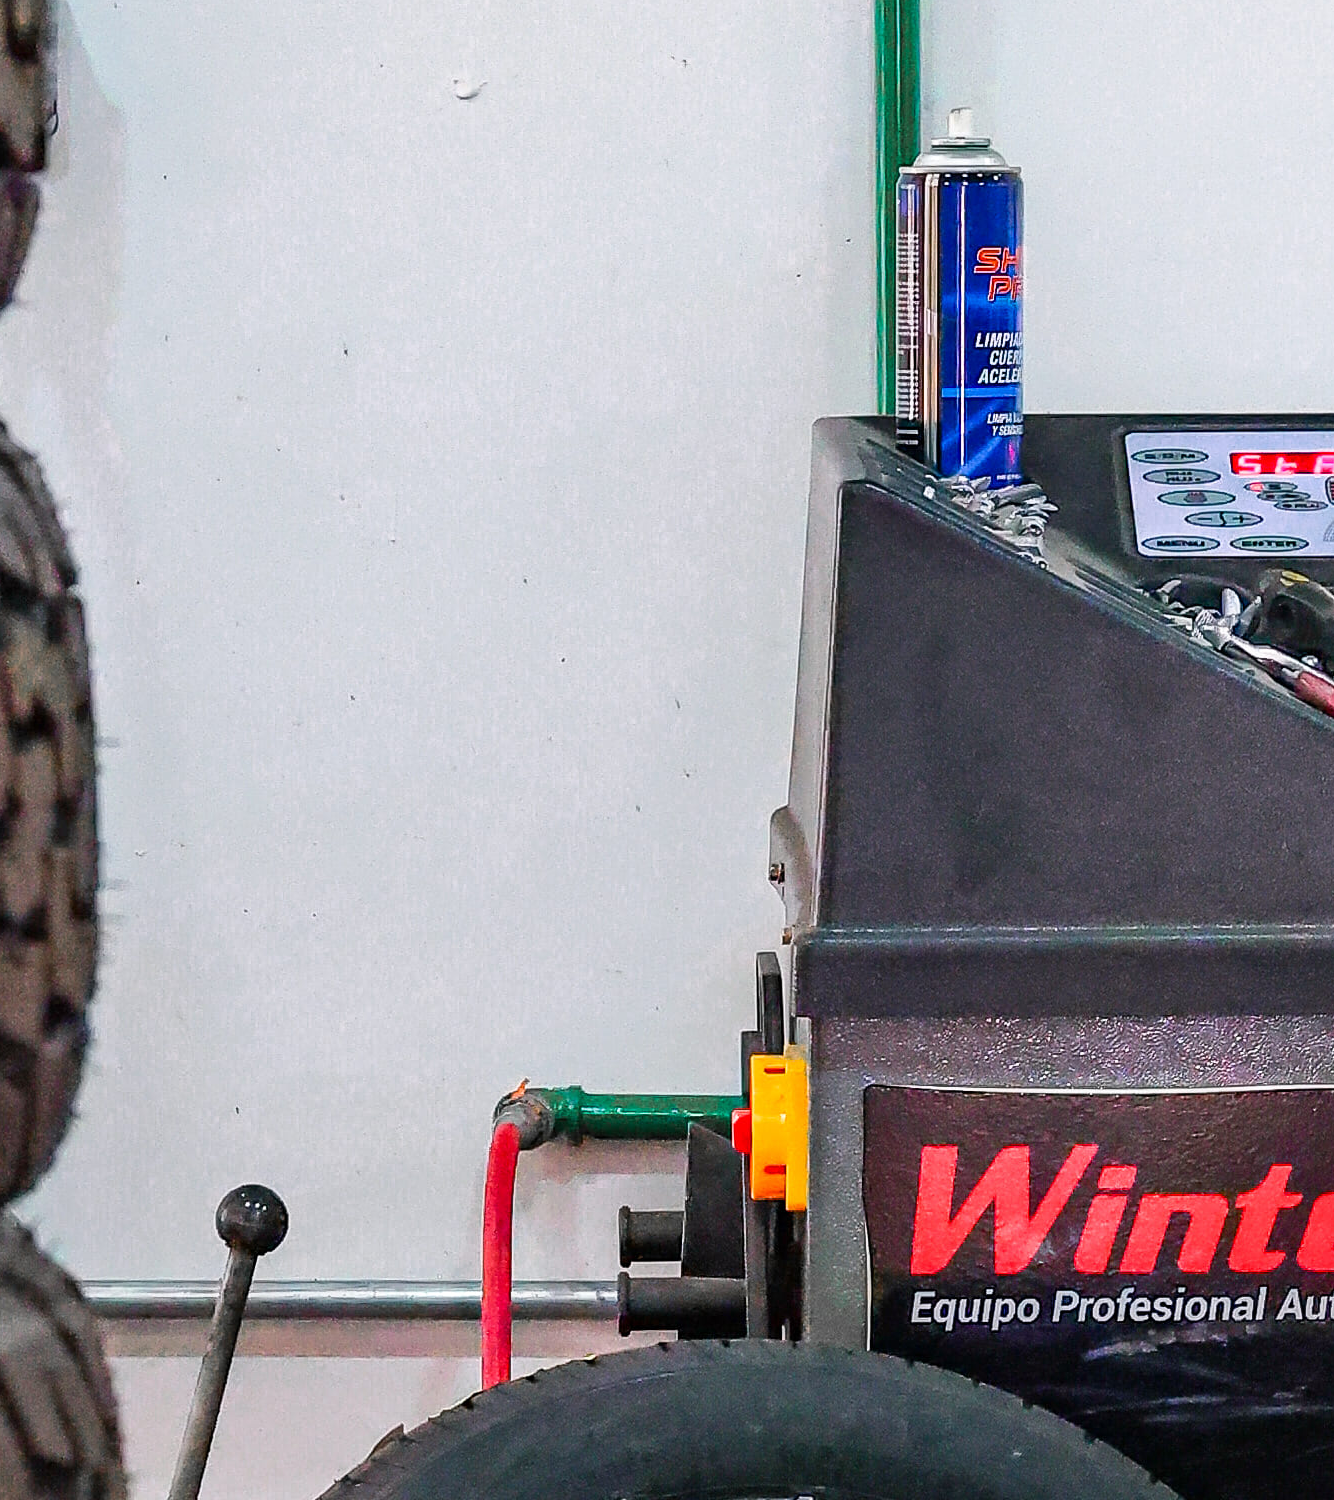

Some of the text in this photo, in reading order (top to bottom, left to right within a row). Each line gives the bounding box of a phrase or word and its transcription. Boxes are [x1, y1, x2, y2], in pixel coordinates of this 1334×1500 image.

[1156, 539, 1206, 548] MENU
[910, 1288, 1041, 1332] Equipo
[1052, 1286, 1269, 1323] Profesional
